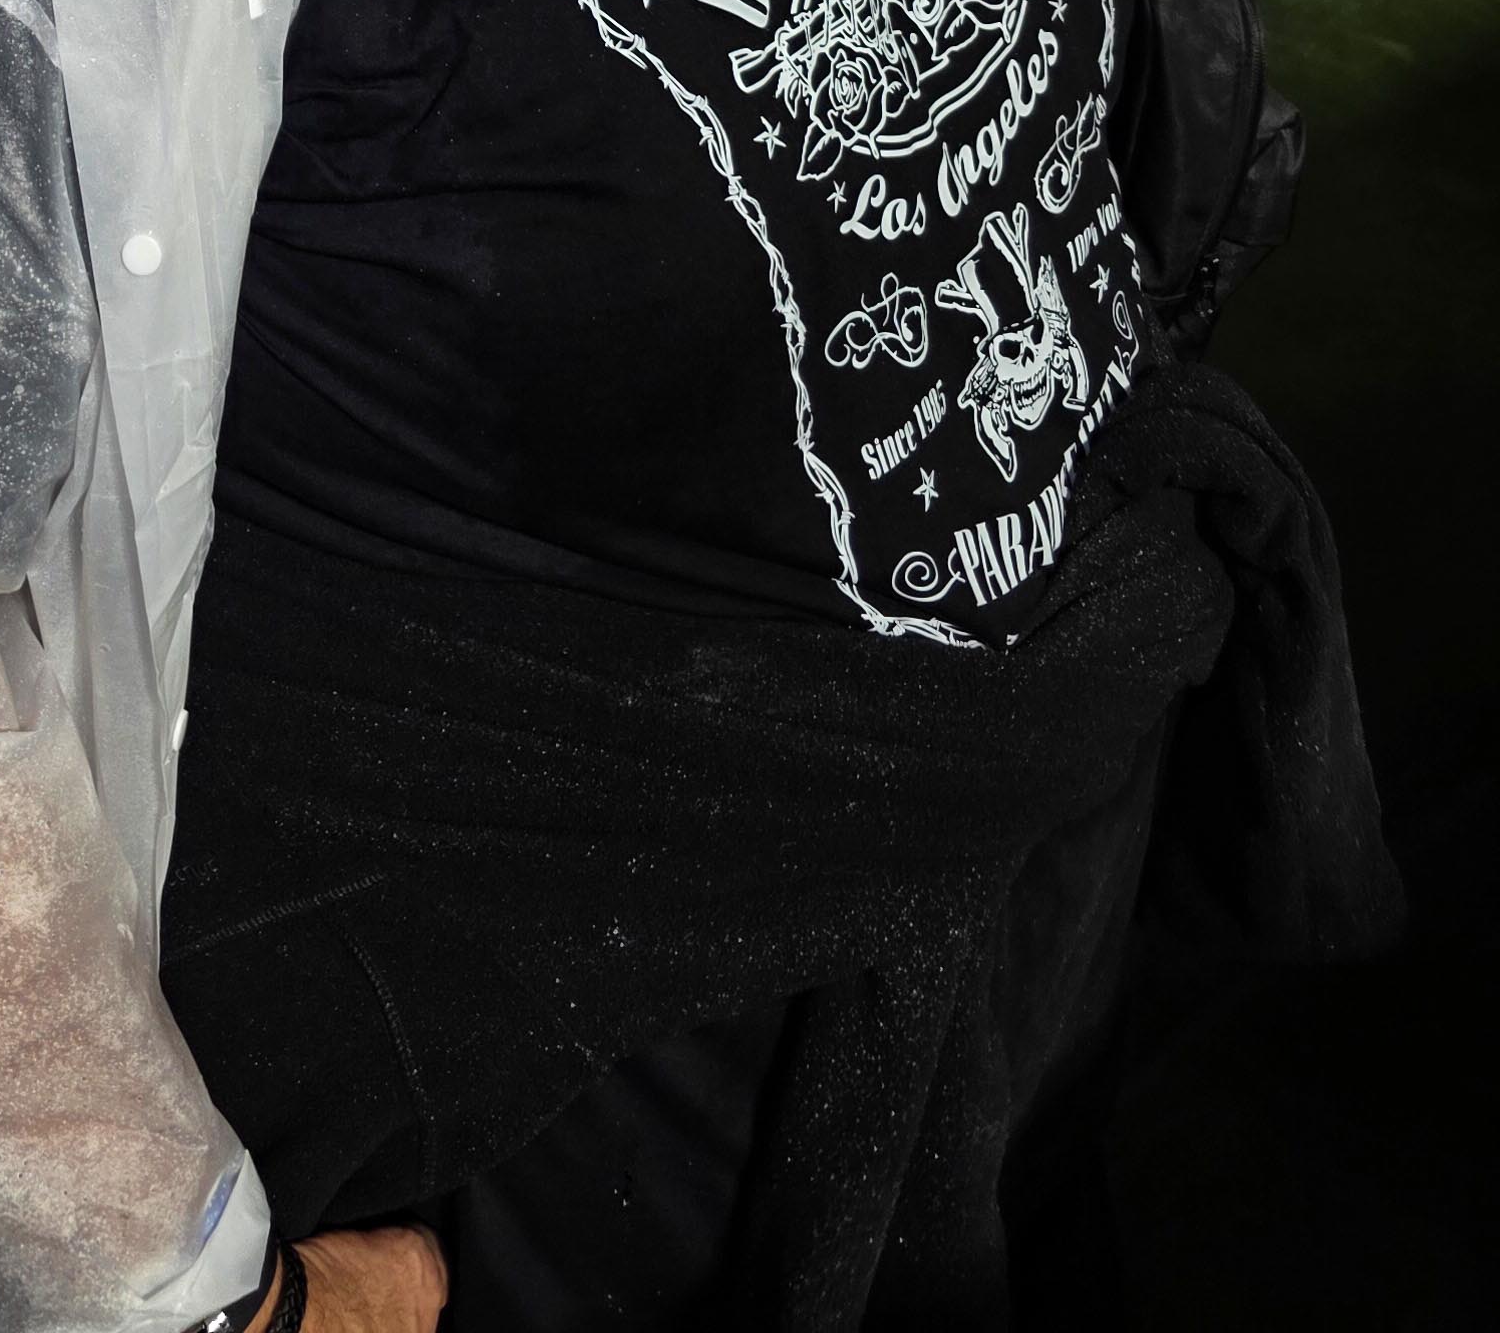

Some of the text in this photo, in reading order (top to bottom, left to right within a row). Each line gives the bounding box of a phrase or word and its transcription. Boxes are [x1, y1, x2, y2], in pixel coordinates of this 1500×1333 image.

[840, 29, 1058, 240] Los Angeles
[861, 420, 917, 480] Since
